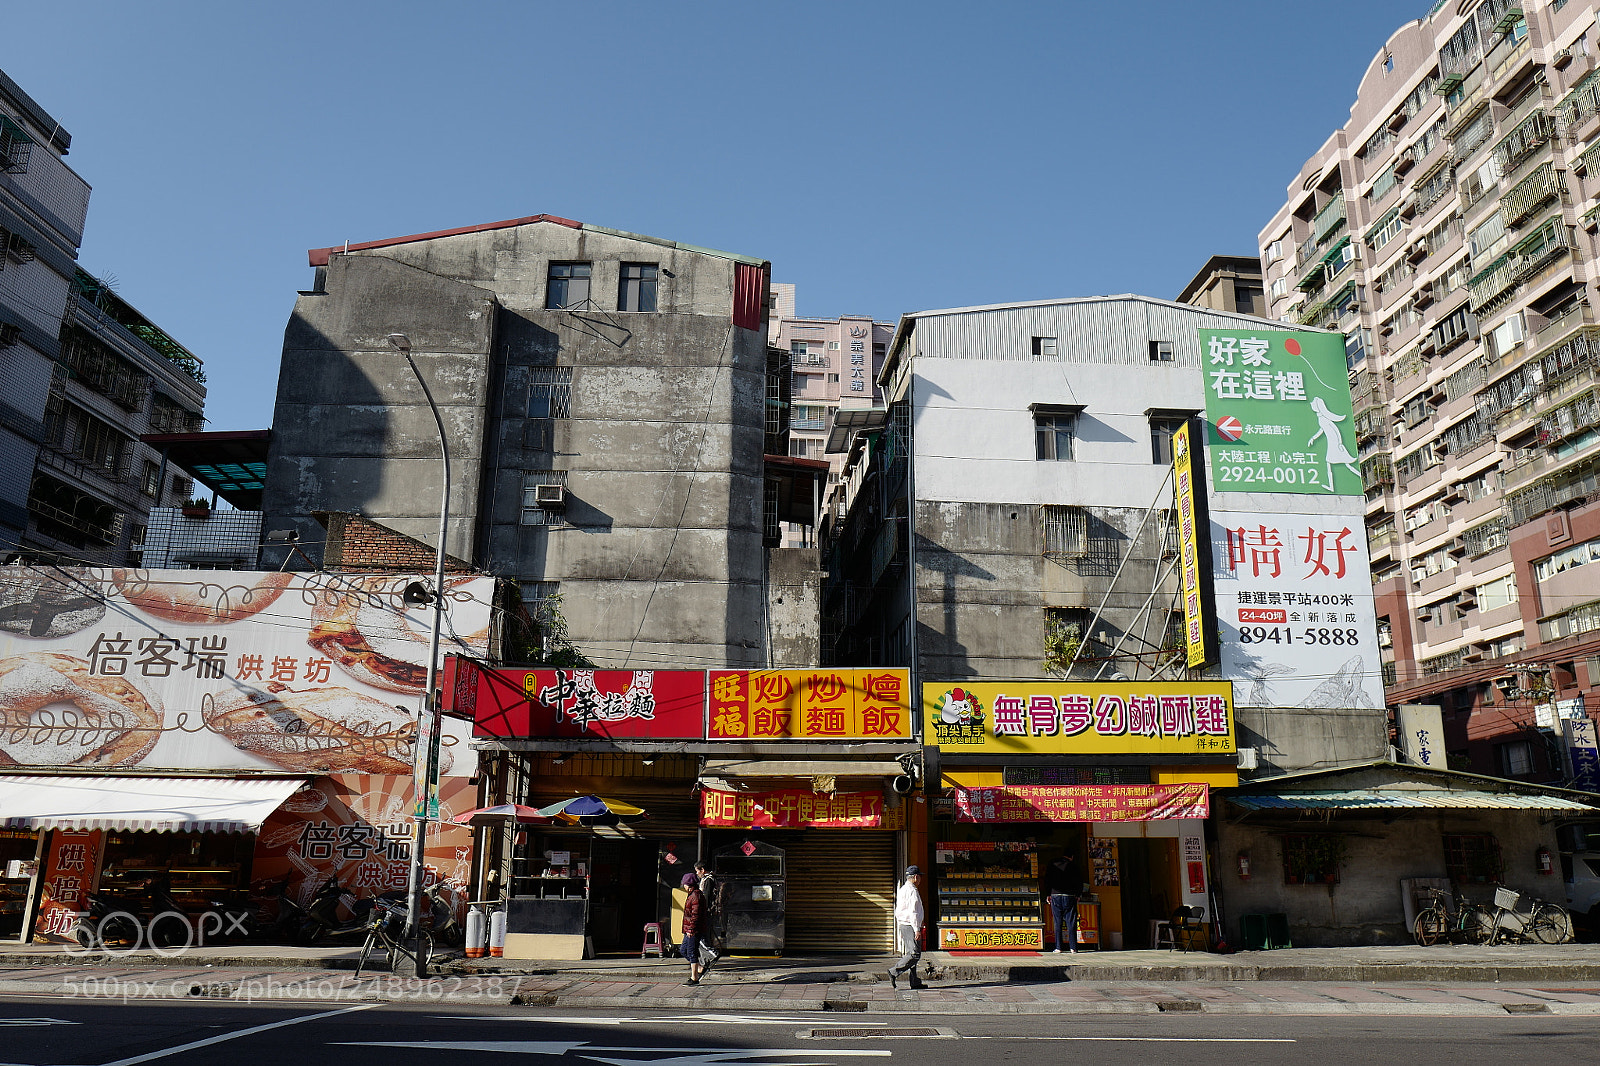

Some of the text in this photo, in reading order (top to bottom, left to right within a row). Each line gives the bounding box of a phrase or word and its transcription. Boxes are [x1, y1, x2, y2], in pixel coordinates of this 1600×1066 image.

[1208, 336, 1272, 367] 好家
[1209, 368, 1307, 401] 在這裡
[1244, 424, 1292, 436] 永元路直行
[1218, 450, 1319, 465] 大陸工程 心完工
[1219, 466, 1320, 485] 2924-0012
[1237, 590, 1354, 607] 捷運景平站400米
[1241, 611, 1284, 621] 24-40坪
[1239, 626, 1359, 646] 8941-5888
[86, 631, 333, 684] 倍客瑞 烘培坊
[712, 673, 746, 737] 旺福
[752, 673, 794, 737] 炒飯
[806, 673, 847, 737] 炒麵
[861, 673, 902, 737] 燴飯
[993, 694, 1227, 738] 無骨夢幻鹹酥雞
[936, 724, 984, 737] 頂尖高手
[1571, 720, 1591, 745] 防水
[1416, 729, 1432, 766] 家電
[957, 788, 995, 804] 感謝各
[1002, 799, 1033, 808] 三立新聞
[1043, 798, 1075, 809] 年代新聞
[1086, 798, 1117, 809] 中天新聞
[1001, 809, 1031, 820] 香港美食
[297, 820, 413, 861] 倍客瑞
[44, 831, 90, 936] 烘培坊
[965, 932, 1039, 946] 真的有夠好吃
